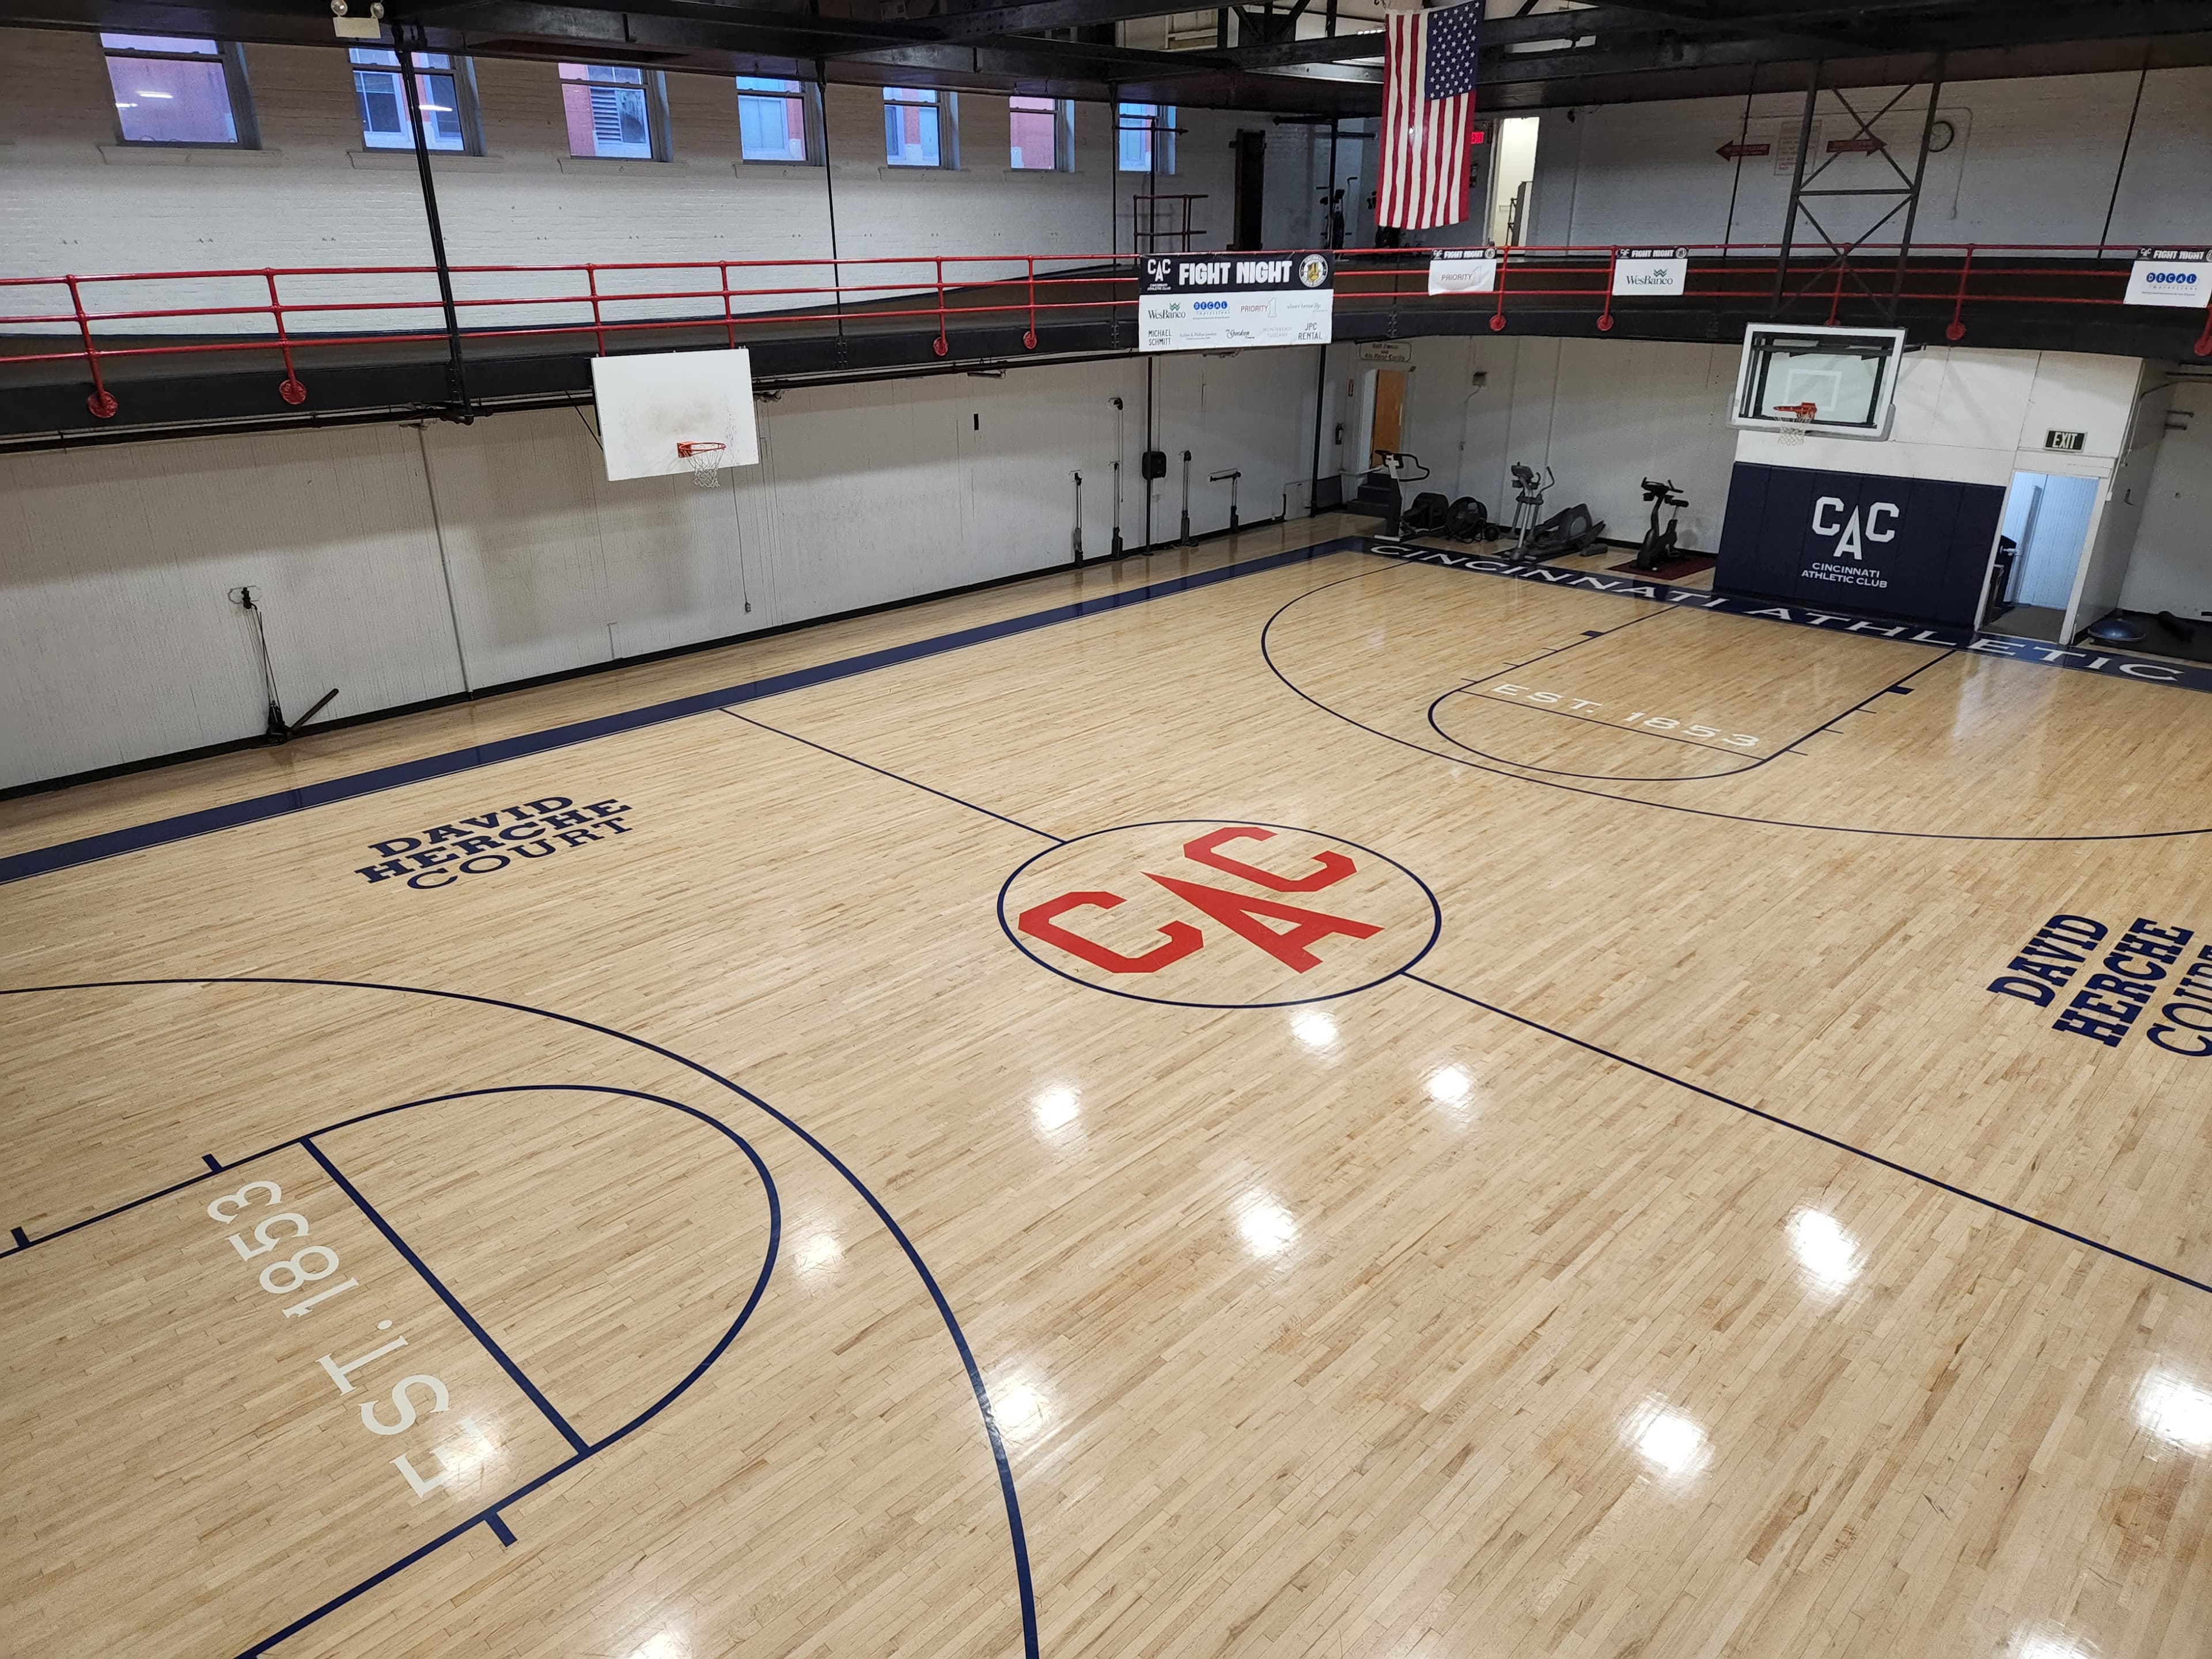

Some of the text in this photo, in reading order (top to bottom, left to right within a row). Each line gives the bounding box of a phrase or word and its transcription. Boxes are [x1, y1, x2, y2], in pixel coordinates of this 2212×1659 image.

[1444, 251, 1463, 259] FIGHT
[1464, 250, 1484, 258] NIGHT
[2153, 250, 2178, 259] FIGHT
[2179, 251, 2205, 260] NIGHT
[1147, 259, 1171, 282] CAC
[1179, 262, 1231, 286] FIGHT
[1236, 260, 1293, 284] NIGHT
[2146, 272, 2197, 284] DECAL
[1626, 275, 1673, 285] WesBanco
[1148, 309, 1186, 319] WesBanco
[1194, 301, 1228, 310] DECAL
[1240, 305, 1268, 313] PRIORITY
[1148, 329, 1172, 338] MICHAEL
[1148, 338, 1171, 346] SCHMITT
[1298, 332, 1323, 340] RENTAL
[2052, 431, 2078, 449] EXIT
[1812, 496, 1900, 560] CAC
[1801, 570, 1888, 588] ATHLETIC CLUB
[1812, 562, 1880, 578] CINCINNATI
[1370, 545, 2186, 682] CINCINNATI ATHLETIC
[1491, 683, 1760, 747] EST. 1853
[368, 796, 573, 858] DAVID
[354, 799, 633, 884] HERCHE
[407, 817, 633, 889] COURT
[1018, 826, 1385, 974] CAC
[1986, 914, 2108, 1007] DAVID
[2051, 917, 2195, 1048] HERCHE
[207, 1180, 359, 1319] 1853
